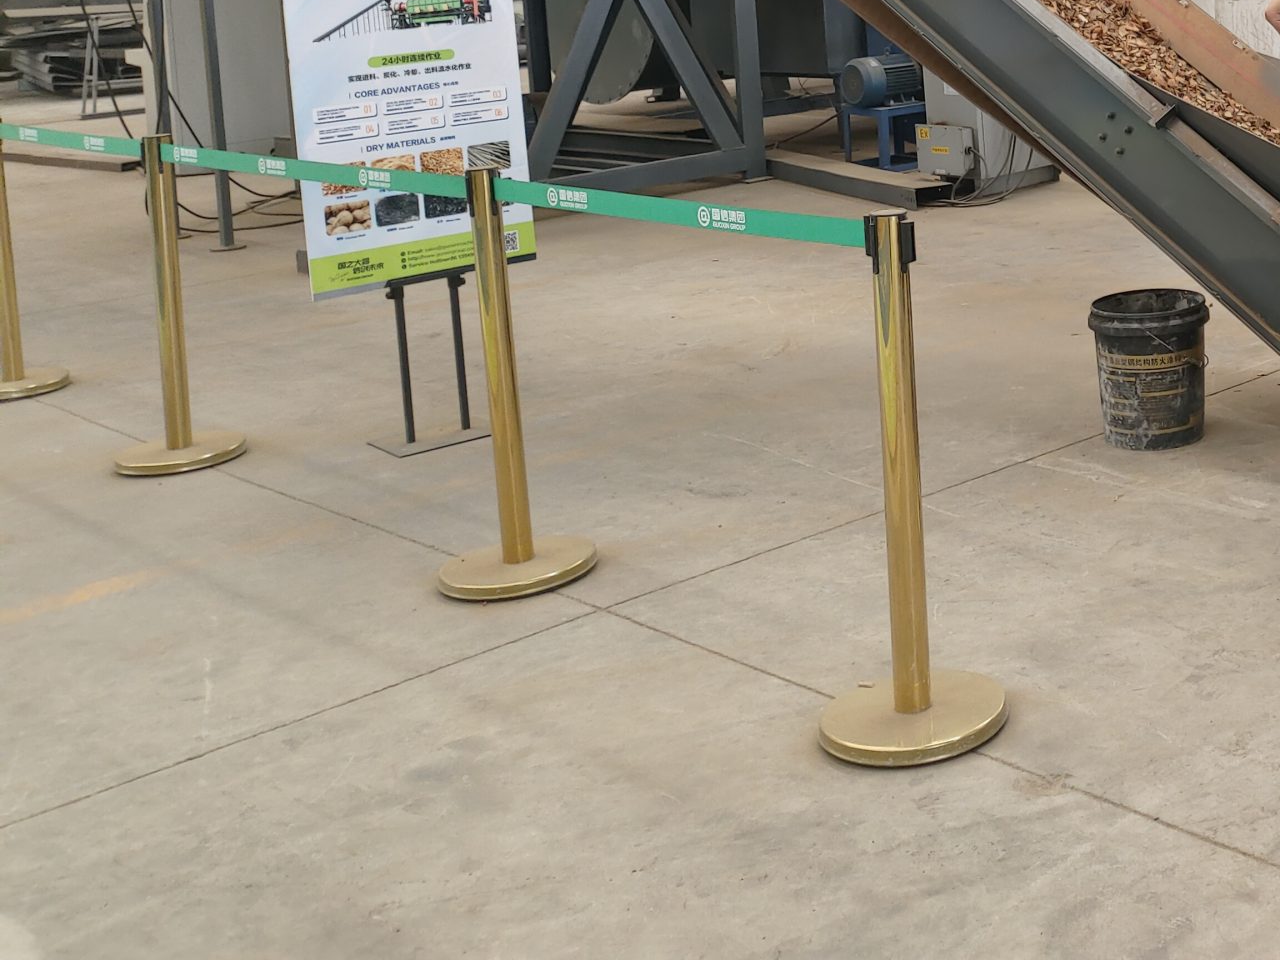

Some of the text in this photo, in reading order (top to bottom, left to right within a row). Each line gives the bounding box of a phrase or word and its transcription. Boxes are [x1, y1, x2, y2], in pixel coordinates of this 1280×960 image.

[381, 52, 441, 66] 24小时连续作业
[354, 88, 380, 99] CORE
[380, 82, 441, 96] ADVANTAGES
[366, 143, 385, 153] DRY
[386, 136, 436, 151] MATERIALS
